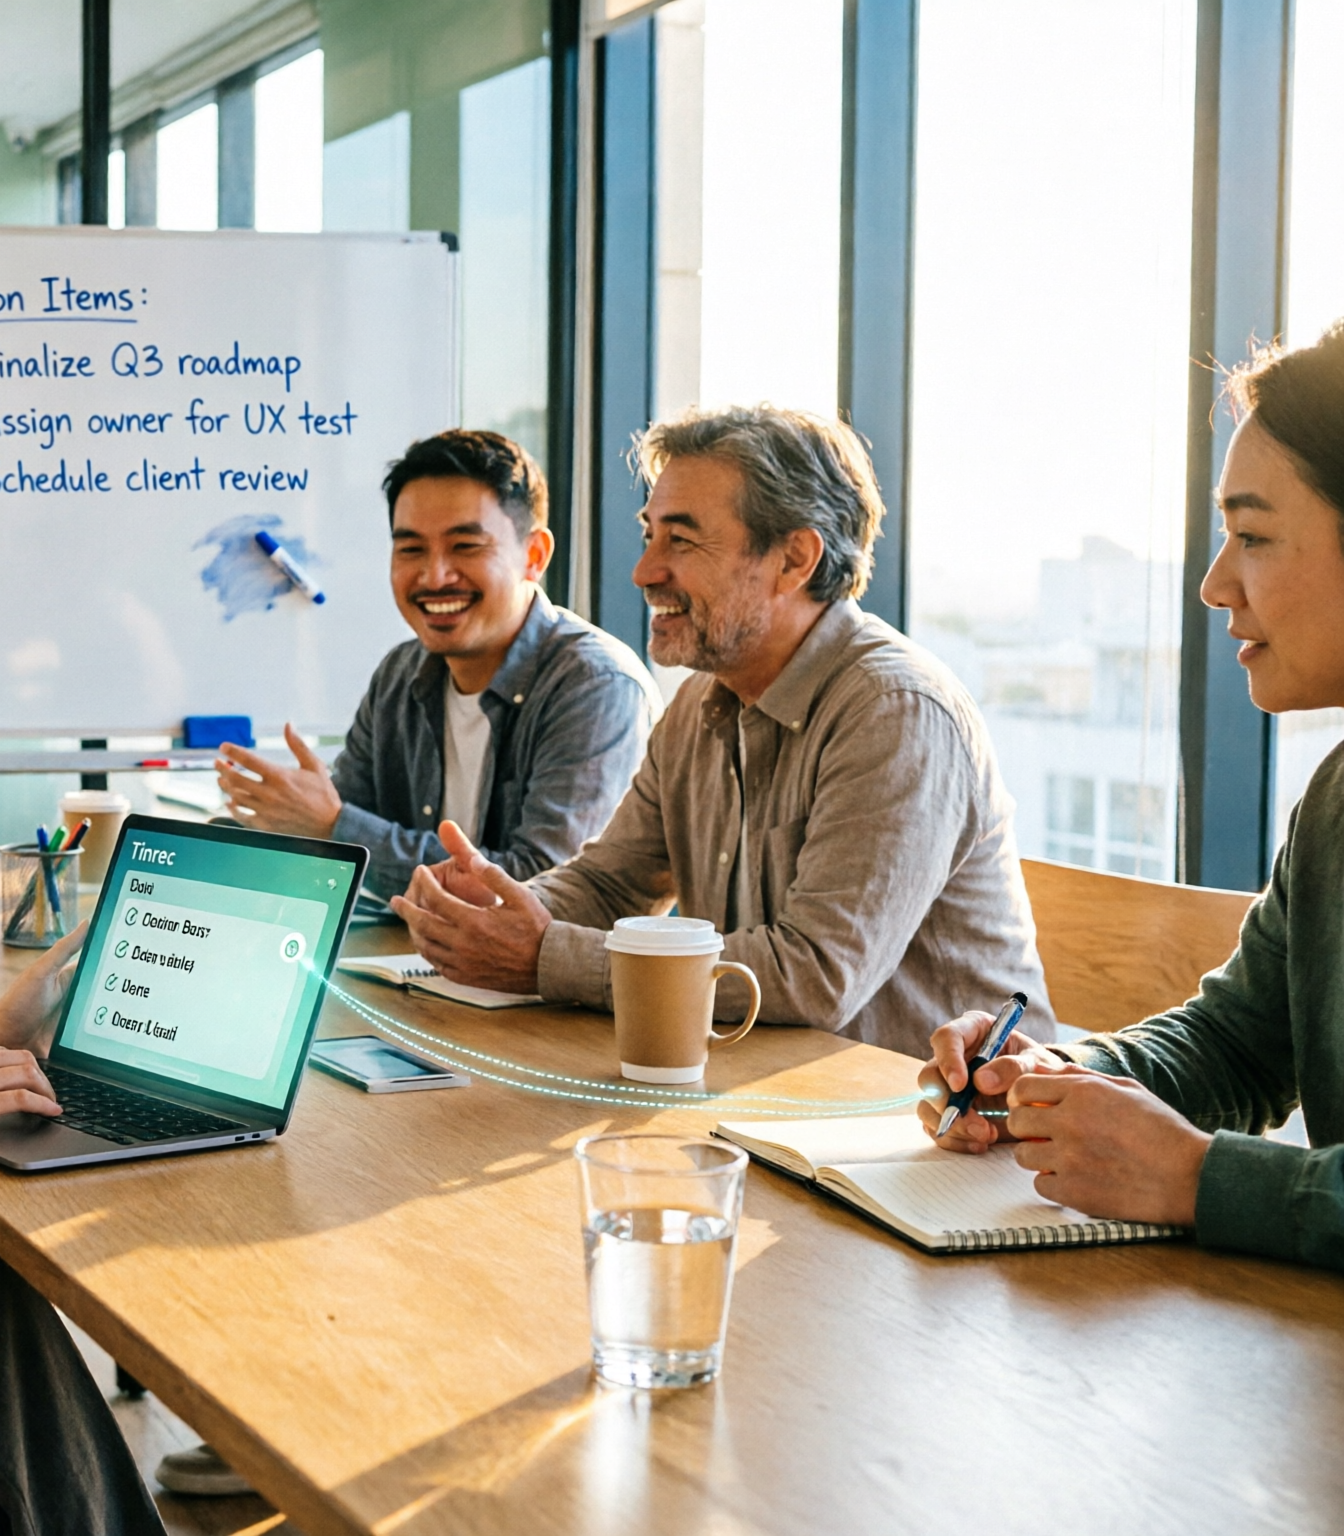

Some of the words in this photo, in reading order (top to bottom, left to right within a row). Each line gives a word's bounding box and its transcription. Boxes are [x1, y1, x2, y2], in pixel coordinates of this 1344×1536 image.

[41, 277, 149, 313] Items:
[111, 341, 164, 379] Q3
[178, 340, 302, 392] roadmap
[88, 413, 173, 435] owner
[185, 398, 230, 435] for
[244, 402, 287, 436] UX
[298, 400, 359, 436] test
[126, 456, 206, 493] client
[218, 466, 309, 494] review
